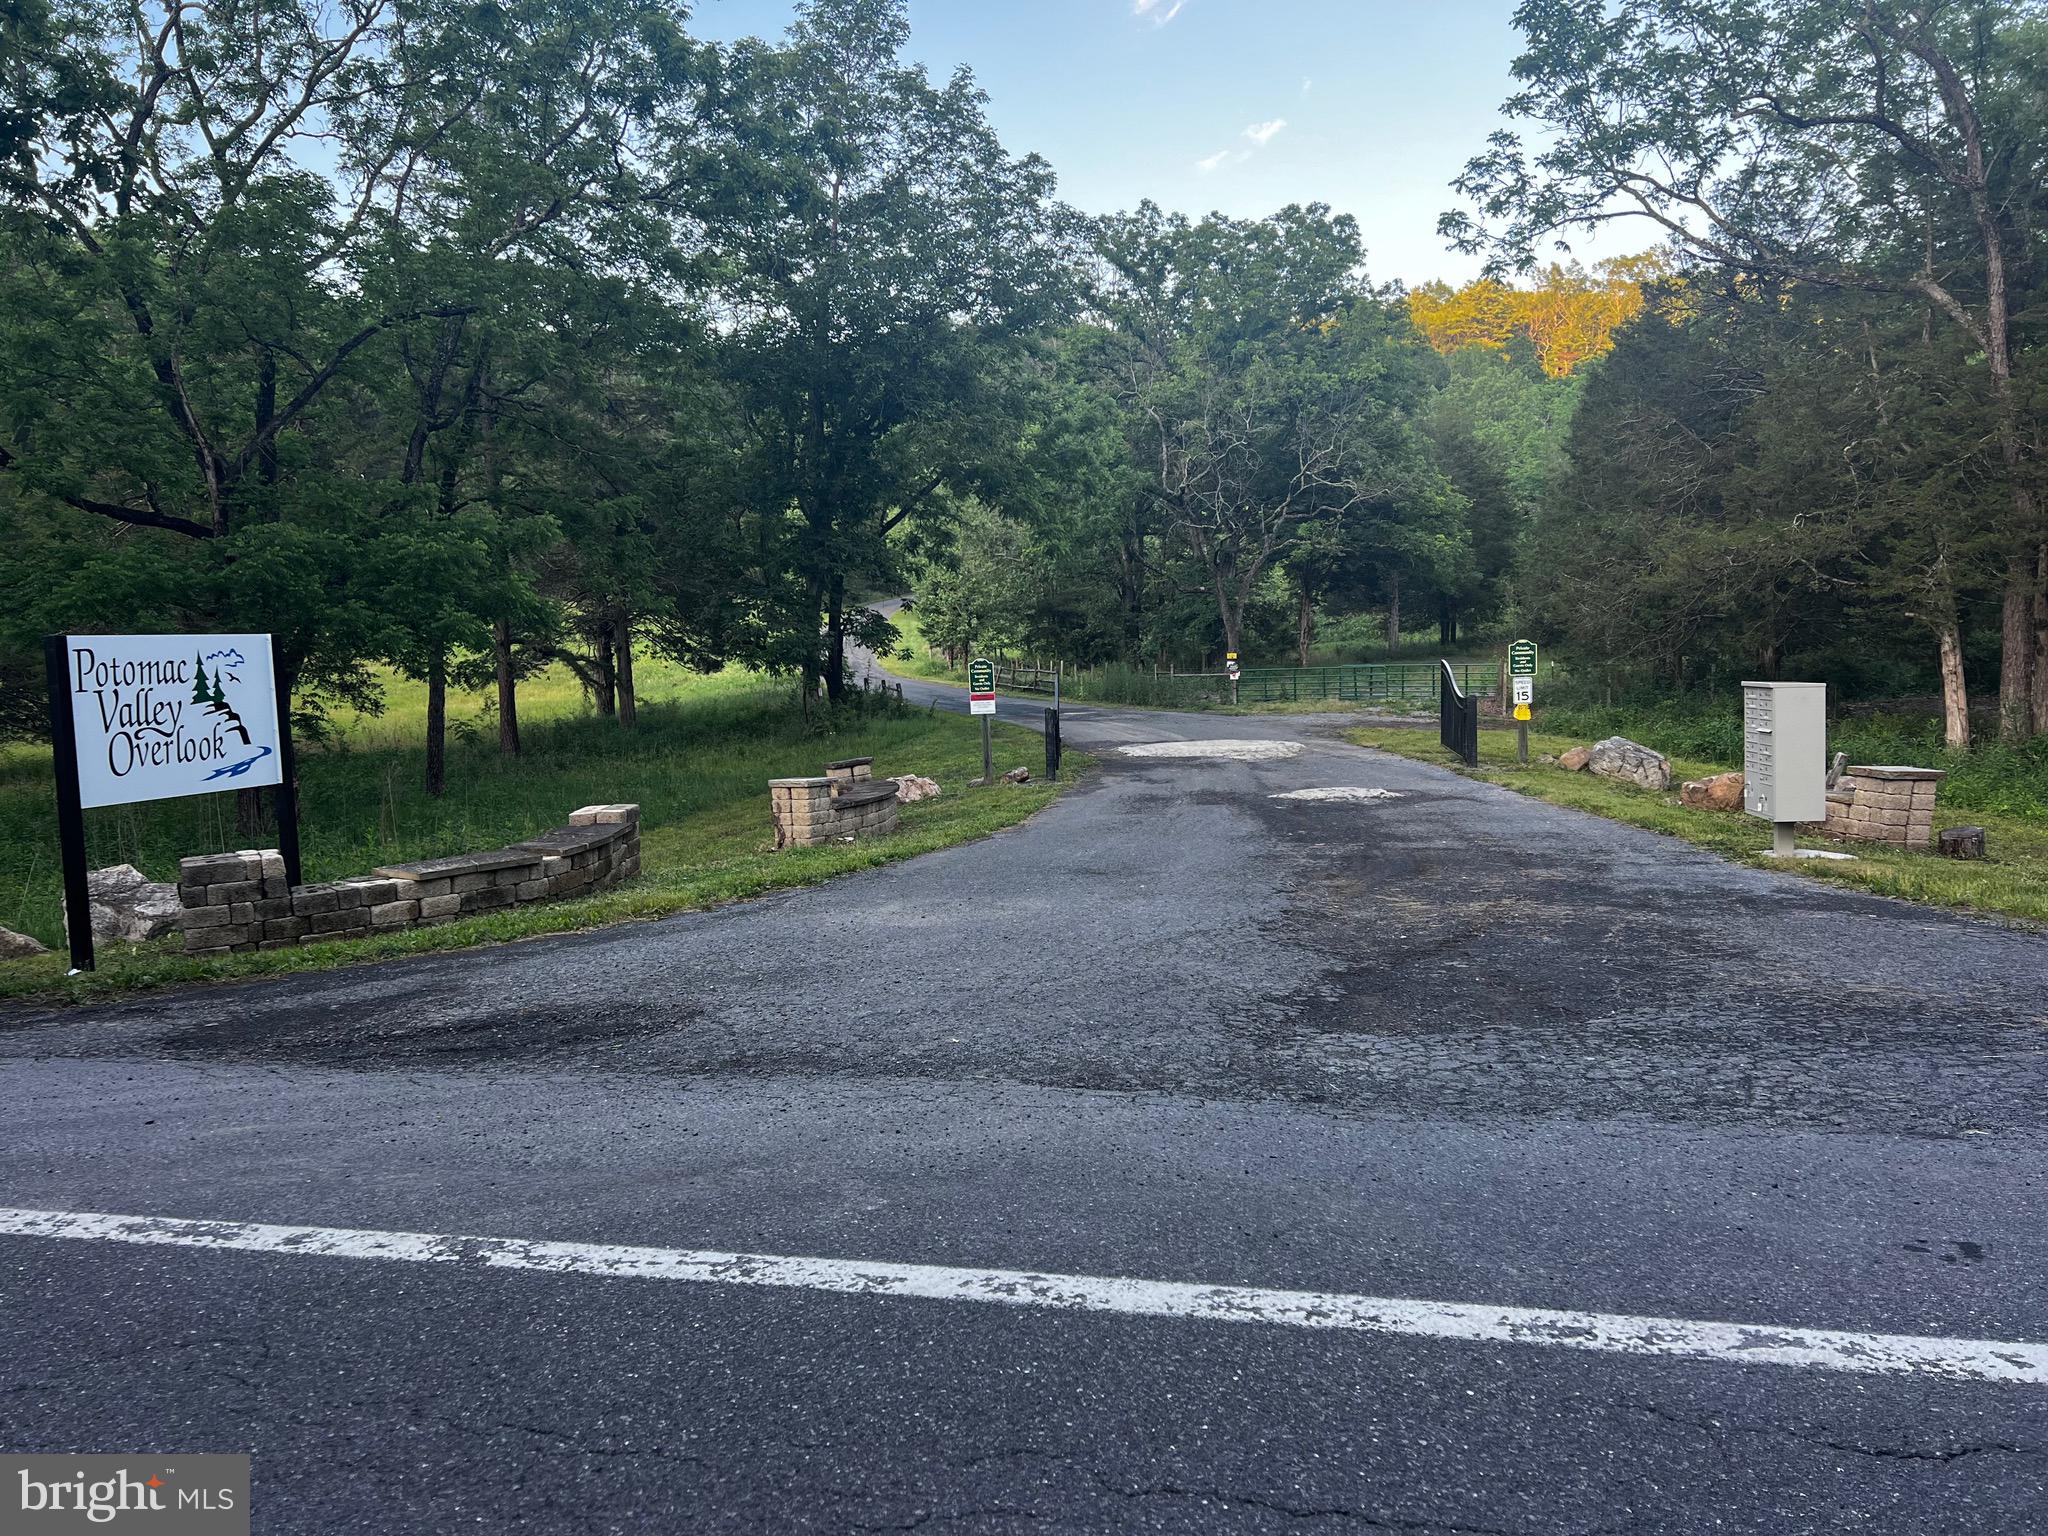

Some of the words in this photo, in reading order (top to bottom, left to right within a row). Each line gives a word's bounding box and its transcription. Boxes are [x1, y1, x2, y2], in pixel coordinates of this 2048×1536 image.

[72, 648, 190, 693] Potomac
[93, 688, 182, 740] Valley
[1516, 691, 1530, 700] 15
[108, 722, 227, 777] Overlook
